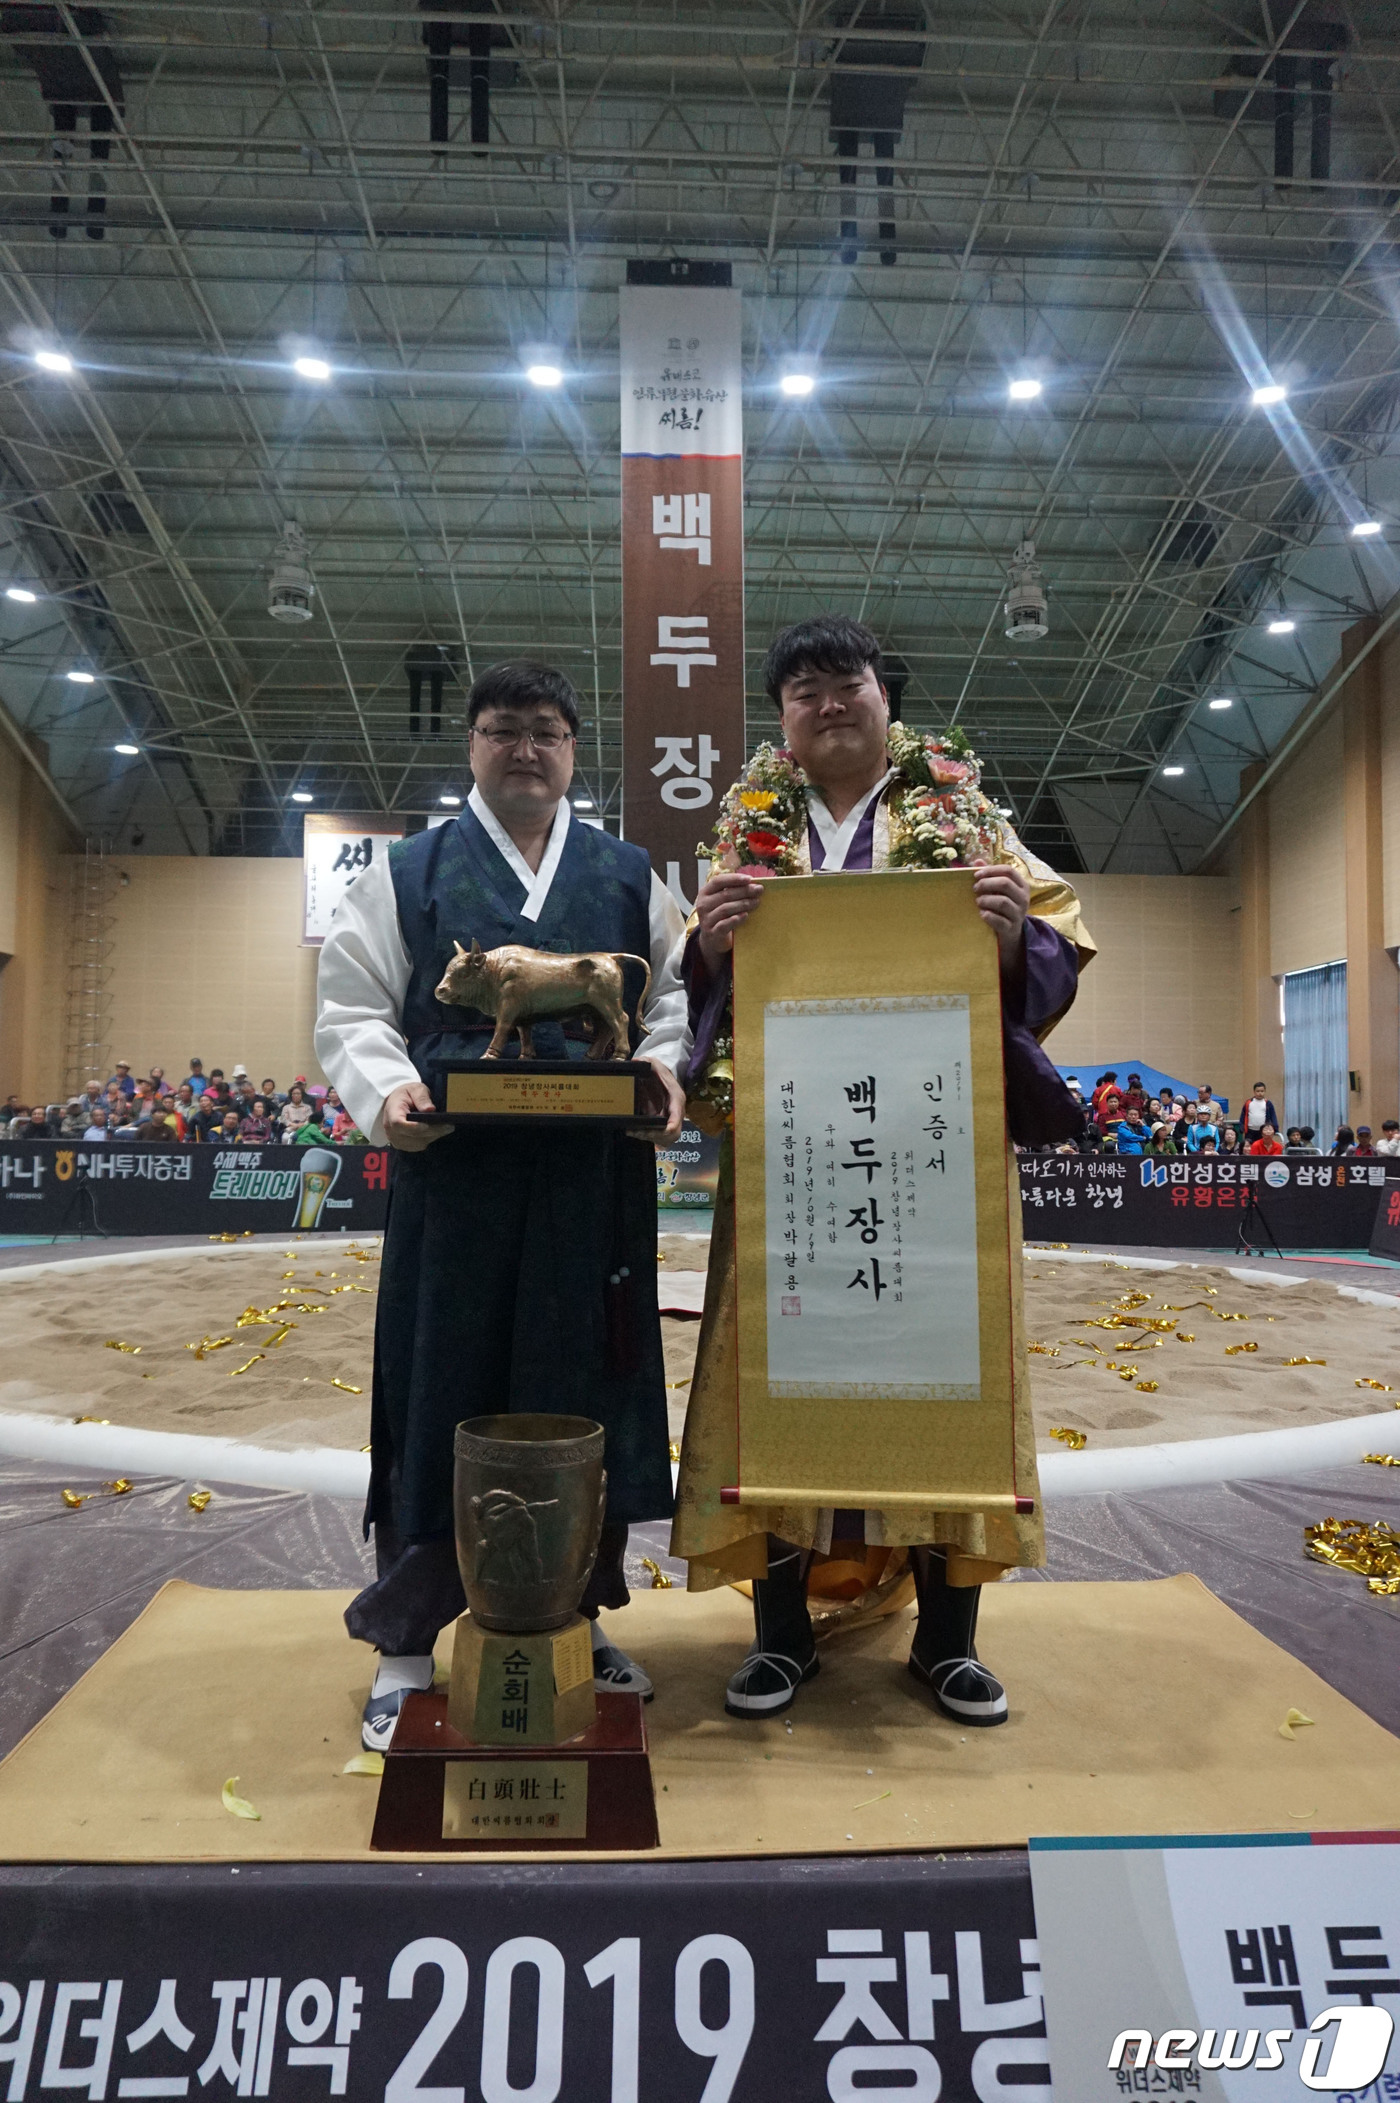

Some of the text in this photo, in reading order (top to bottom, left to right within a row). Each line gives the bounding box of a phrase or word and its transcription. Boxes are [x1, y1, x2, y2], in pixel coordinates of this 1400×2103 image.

[658, 407, 704, 431] 씨름!
[780, 1080, 797, 1187] 대한씨름협회
[922, 1074, 948, 1175] 인증서
[890, 1151, 899, 1185] 2019
[1087, 1161, 1127, 1178] 인사하는
[1169, 1161, 1259, 1185] 한성호텔
[1295, 1165, 1333, 1187] 삼성
[1349, 1165, 1386, 1187] 호텔
[841, 1075, 888, 1302] 백두장사
[1085, 1182, 1124, 1209] 창녕
[501, 1648, 532, 1735] 순회배
[468, 1777, 567, 1801] 白頭壯士
[0, 1976, 364, 2103] 위더스제약
[384, 1935, 756, 2103] 2019
[1115, 2068, 1201, 2093] 위더스제약
